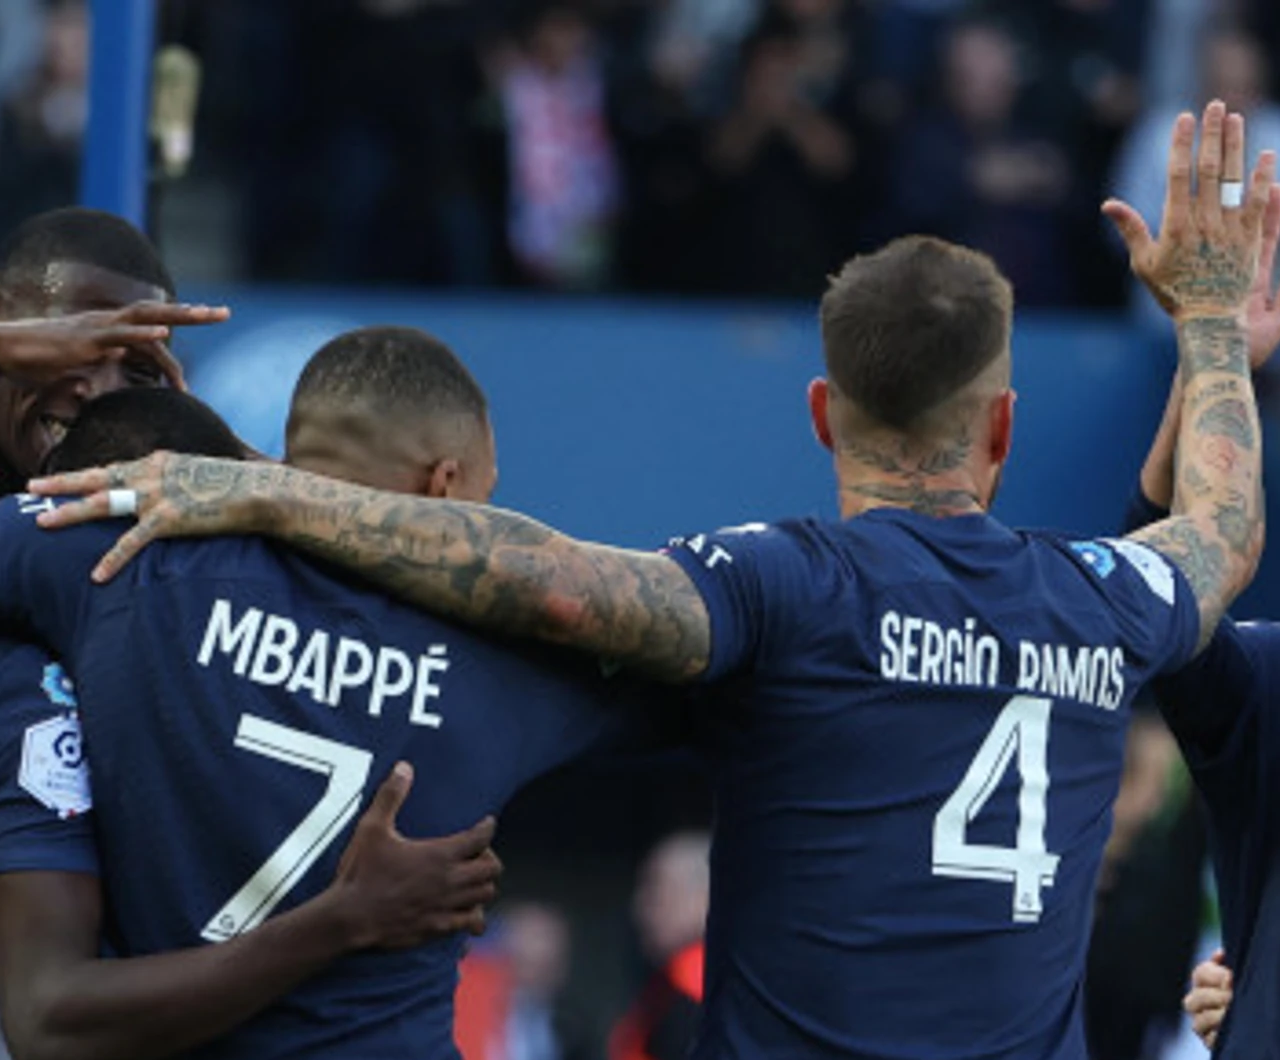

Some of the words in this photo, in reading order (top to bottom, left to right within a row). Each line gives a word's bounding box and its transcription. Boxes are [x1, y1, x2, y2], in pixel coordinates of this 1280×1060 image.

[197, 599, 450, 728] MBAPPÉ
[200, 714, 374, 943] 7
[932, 695, 1061, 922] 4
